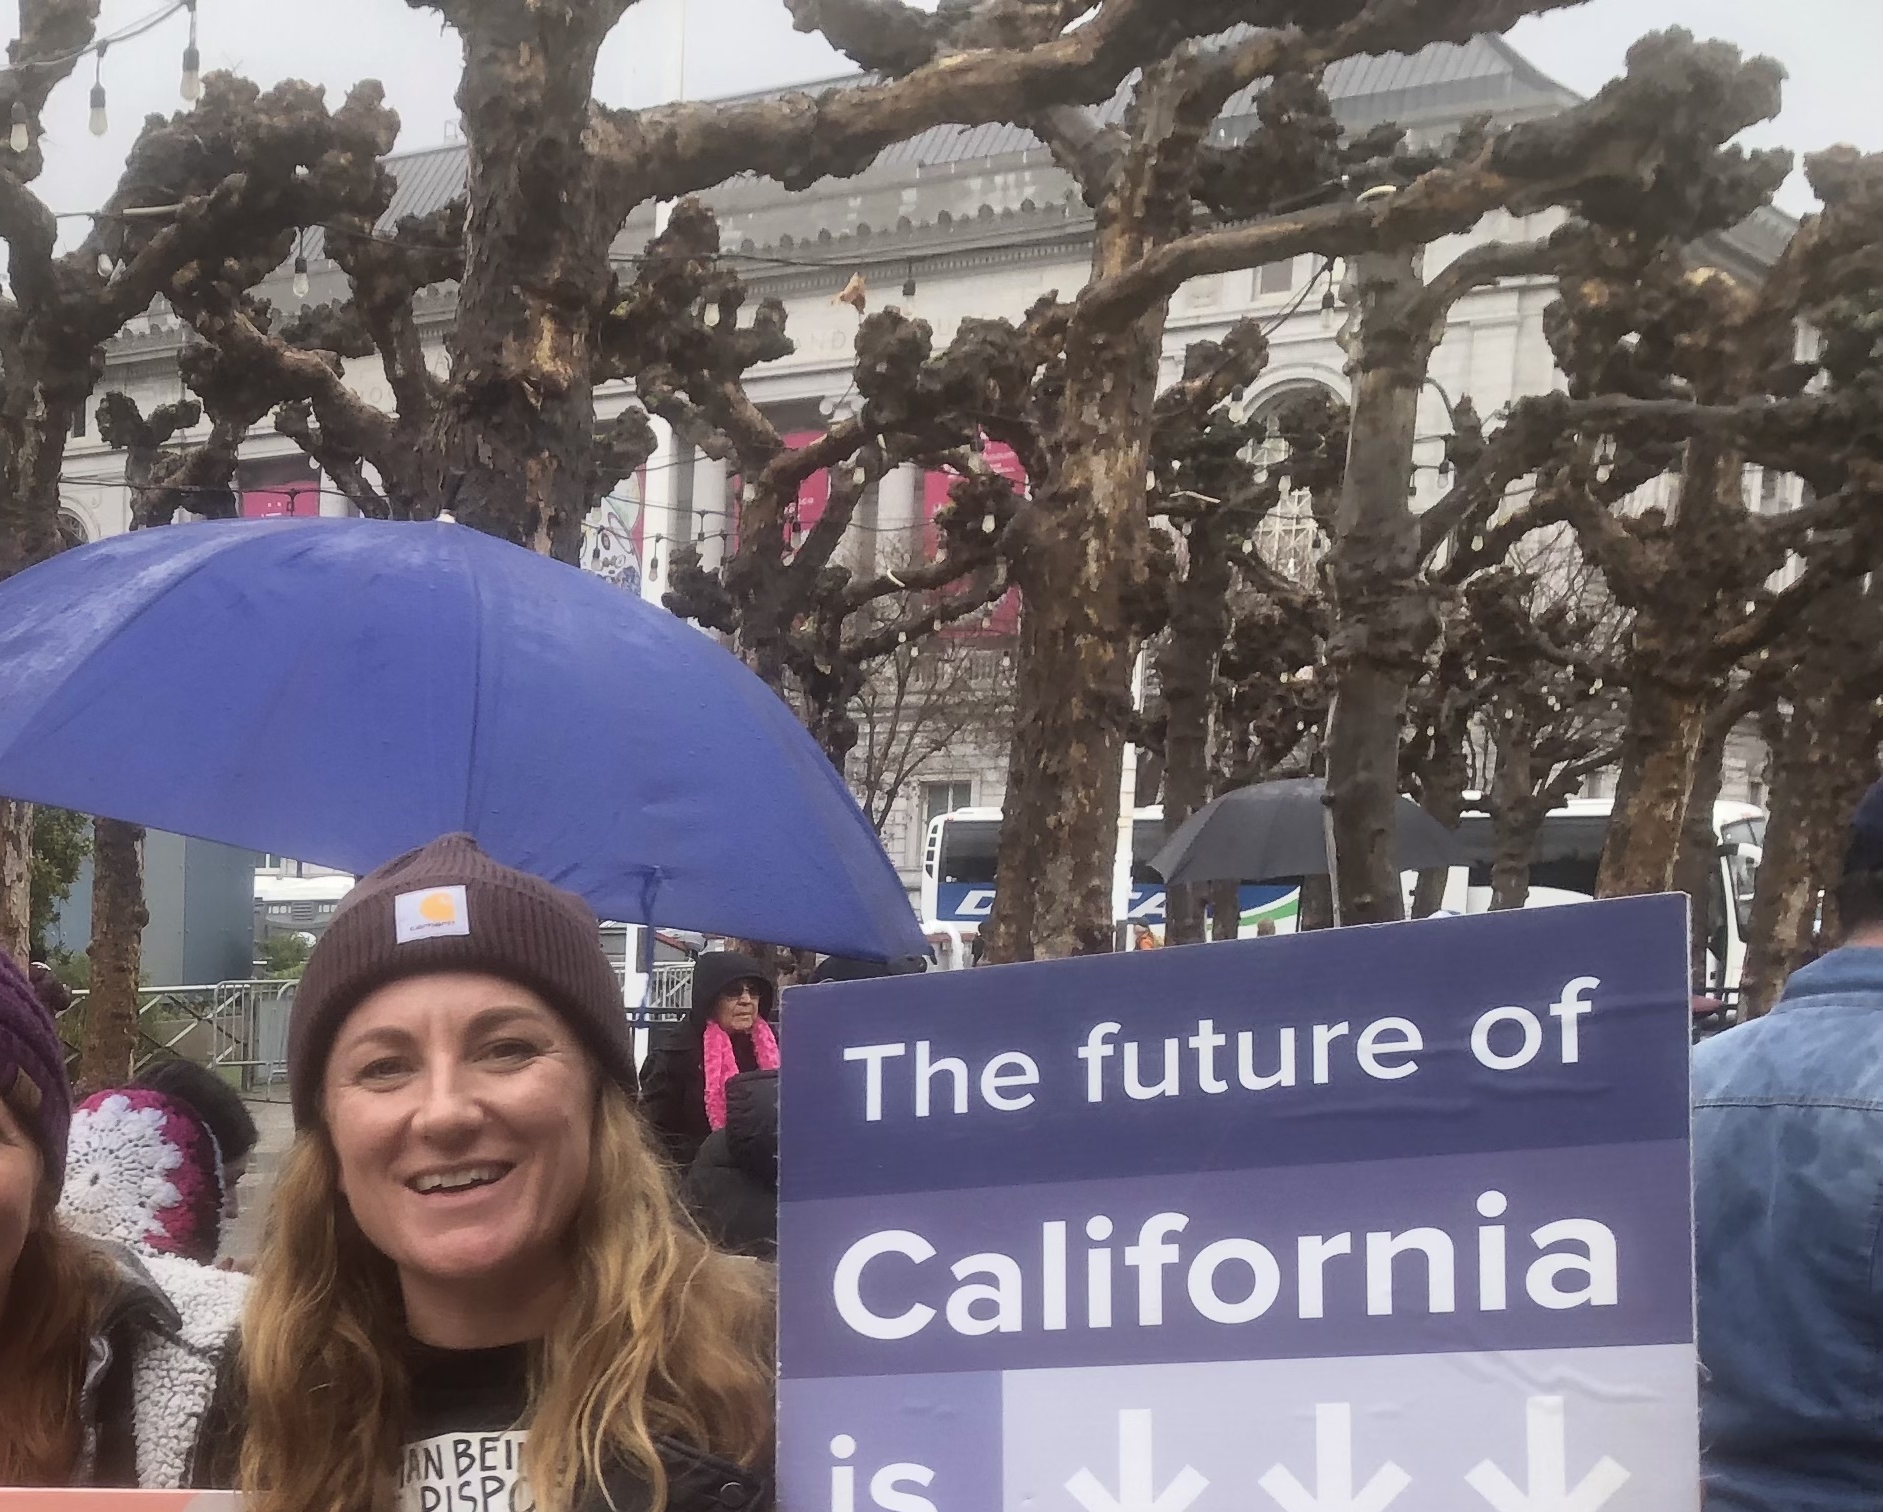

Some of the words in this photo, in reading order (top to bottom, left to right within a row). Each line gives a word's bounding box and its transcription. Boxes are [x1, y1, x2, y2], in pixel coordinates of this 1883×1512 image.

[844, 1041, 1040, 1122] The
[1078, 1017, 1424, 1102] future
[1470, 976, 1601, 1070] of
[833, 1190, 1618, 1340] California
[453, 1436, 525, 1478] BEI
